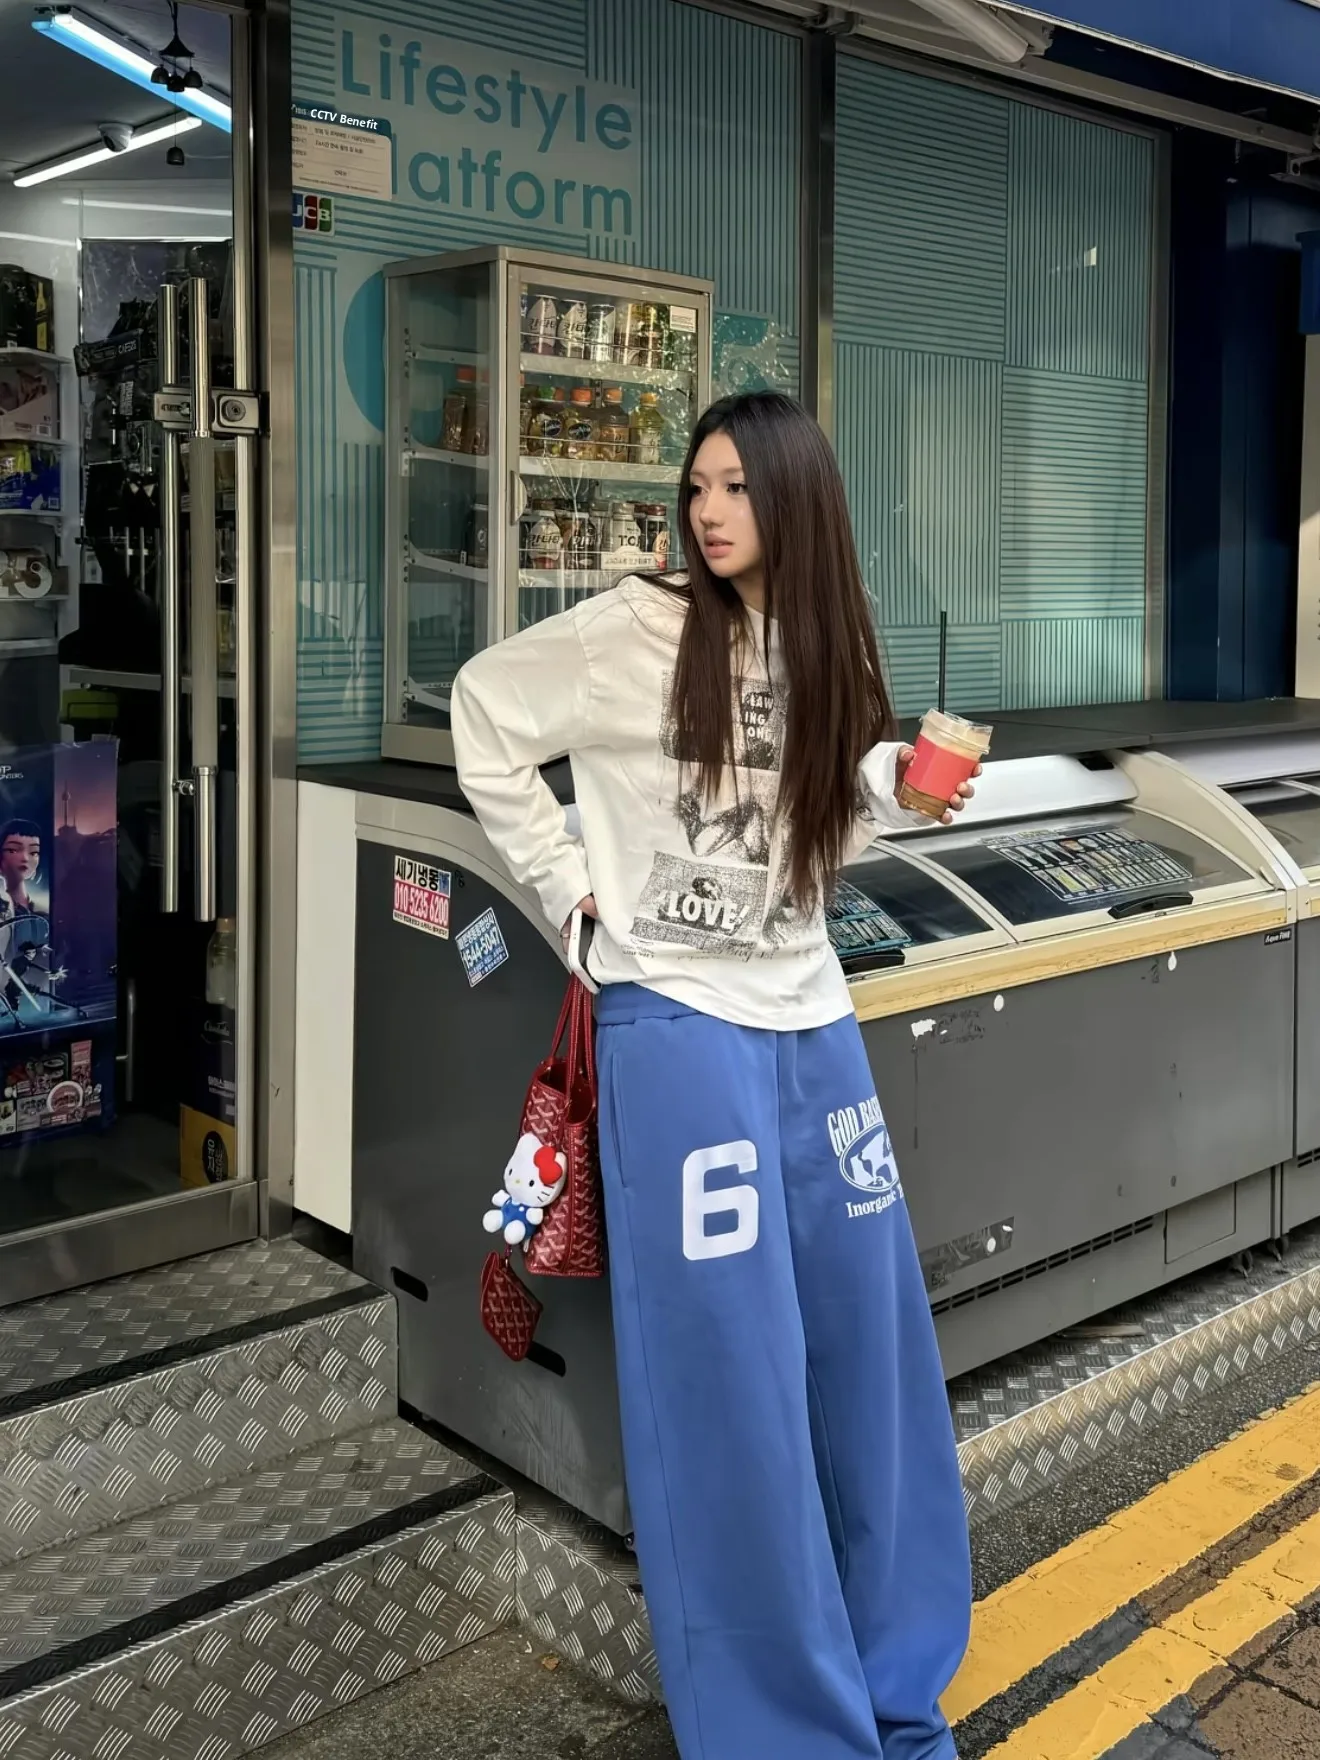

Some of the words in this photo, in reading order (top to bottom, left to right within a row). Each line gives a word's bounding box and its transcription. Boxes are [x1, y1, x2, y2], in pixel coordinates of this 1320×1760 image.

[341, 29, 633, 153] Lifestyle
[310, 108, 337, 121] CCTV
[340, 114, 378, 130] Benefit
[292, 204, 331, 221] JCB
[827, 1105, 860, 1158] GOD
[682, 1138, 759, 1262] 6
